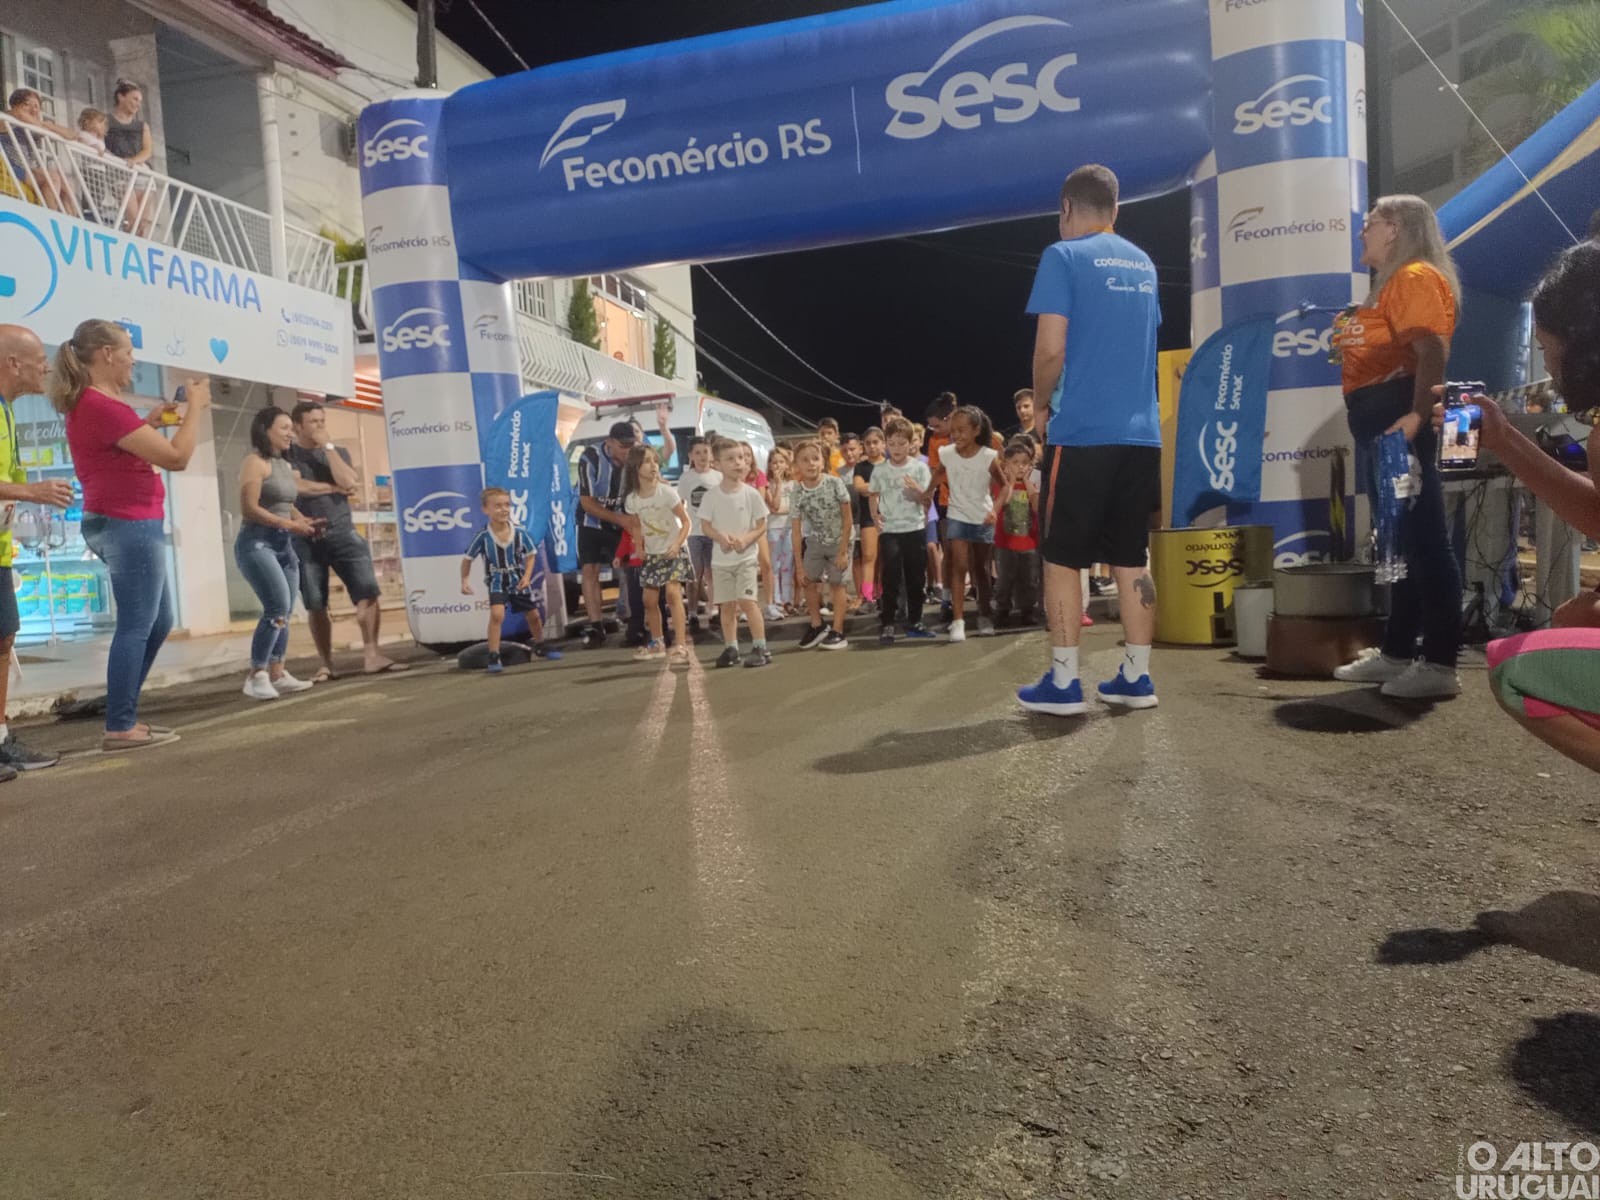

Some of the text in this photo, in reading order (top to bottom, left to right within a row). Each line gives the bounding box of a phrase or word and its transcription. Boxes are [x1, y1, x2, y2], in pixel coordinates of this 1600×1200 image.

[562, 118, 832, 192] Fecomércio RS
[432, 235, 451, 247] RS
[1234, 219, 1346, 243] Fecomércio RS
[50, 218, 262, 313] VITAFARMA
[454, 420, 473, 433] RS
